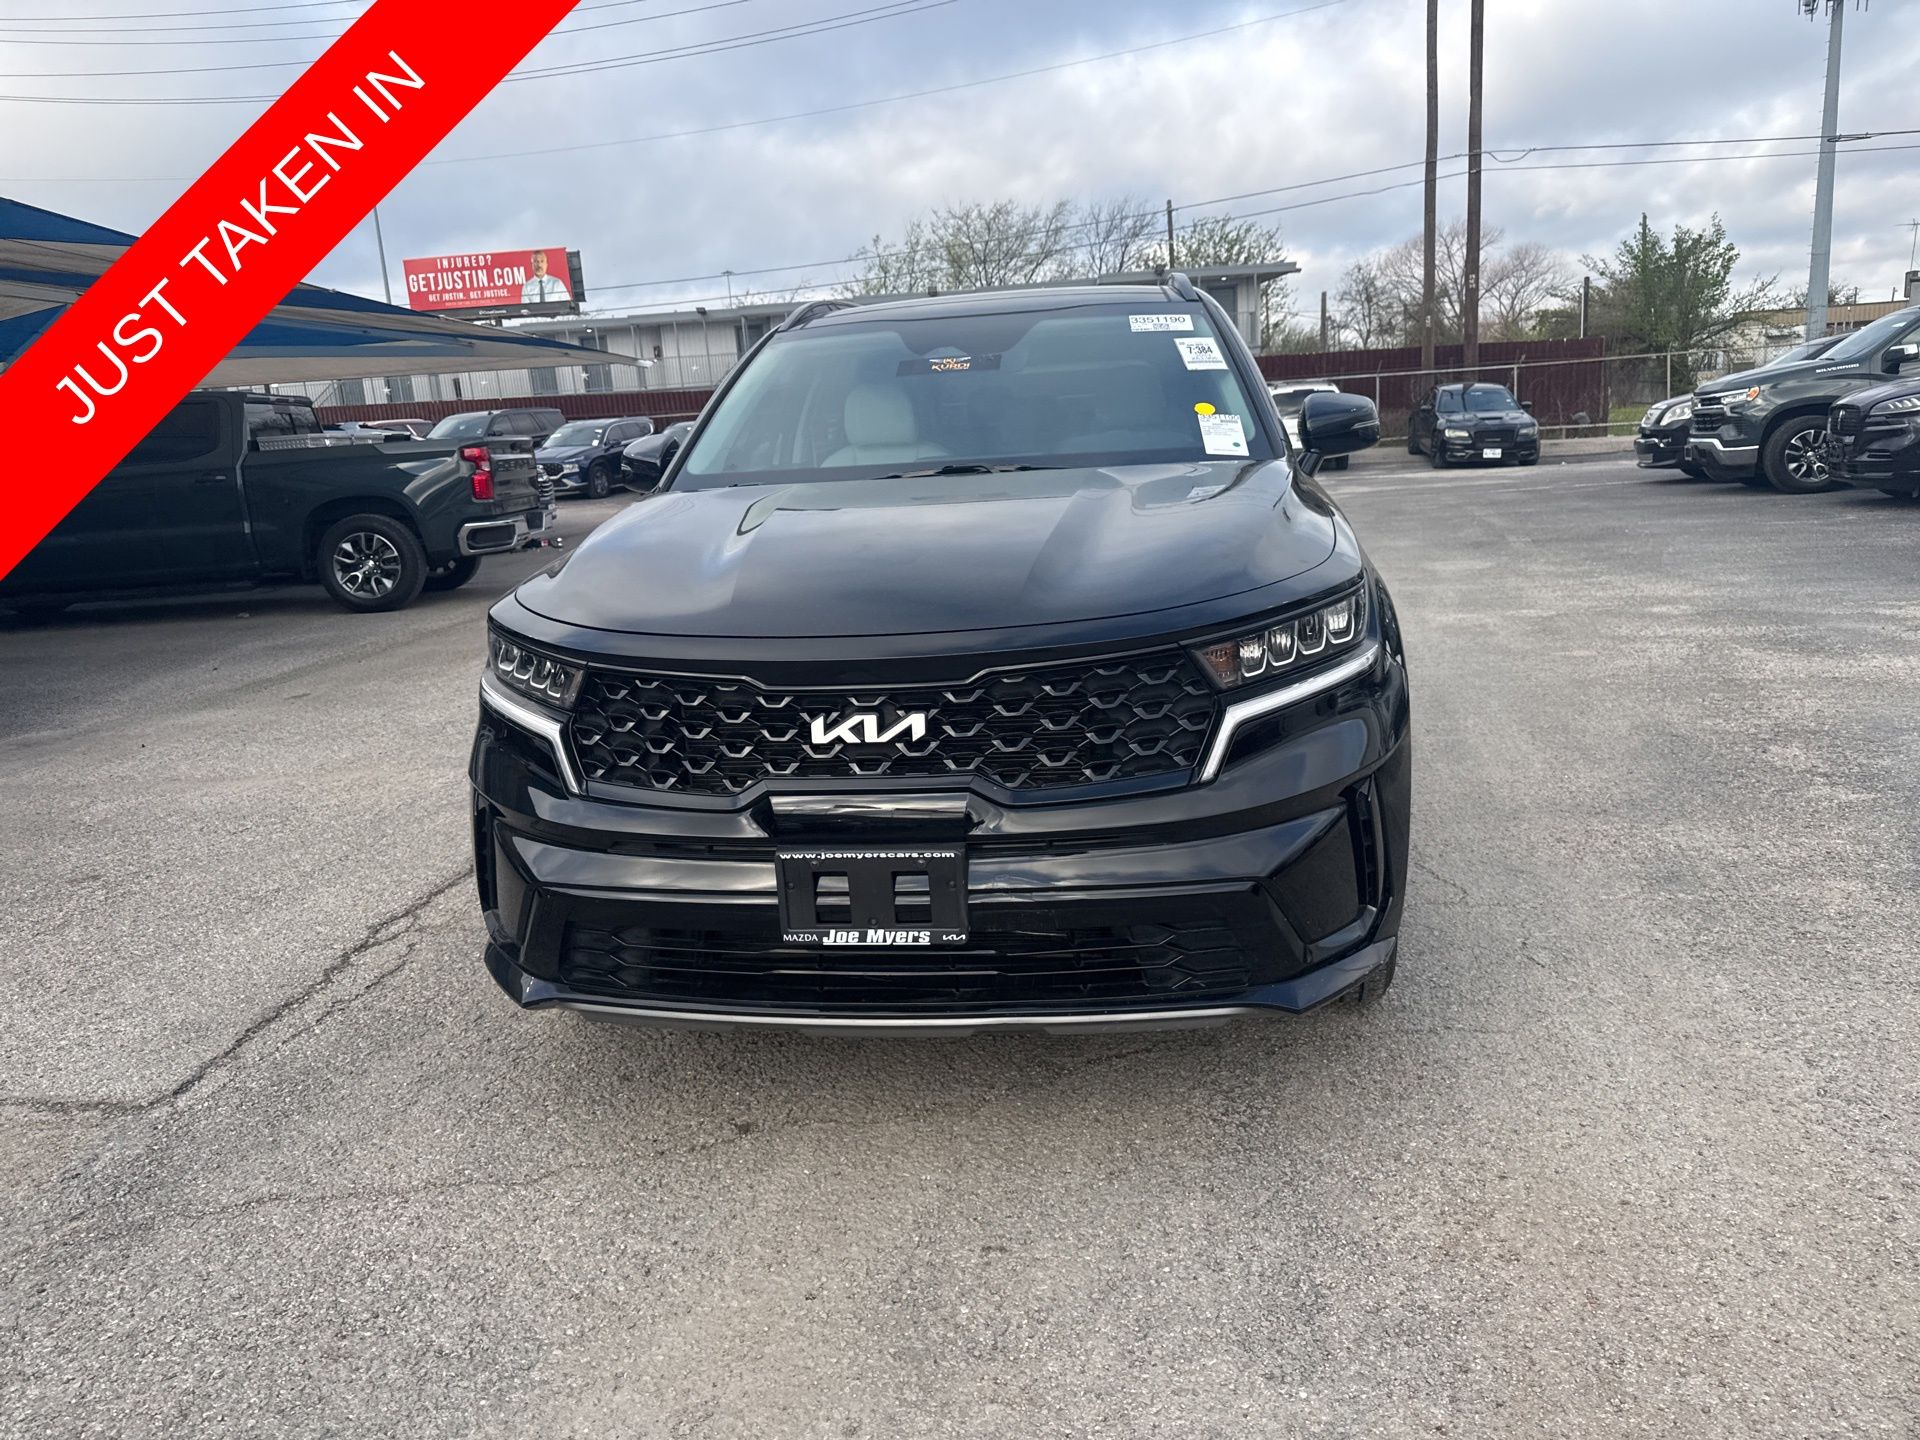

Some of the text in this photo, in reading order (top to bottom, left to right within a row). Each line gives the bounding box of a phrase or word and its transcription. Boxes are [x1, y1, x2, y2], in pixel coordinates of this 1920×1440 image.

[437, 254, 492, 270] INJURED?
[408, 266, 527, 293] GETJUSTIN.COM
[428, 293, 440, 302] GET
[469, 290, 482, 300] GET
[1815, 363, 1860, 373] SILVERADO
[811, 713, 926, 744] KIA
[779, 852, 956, 861] www.joemyerscars.com
[783, 934, 818, 942] MAZDA
[823, 929, 859, 943] Joe
[866, 929, 931, 945] Myers
